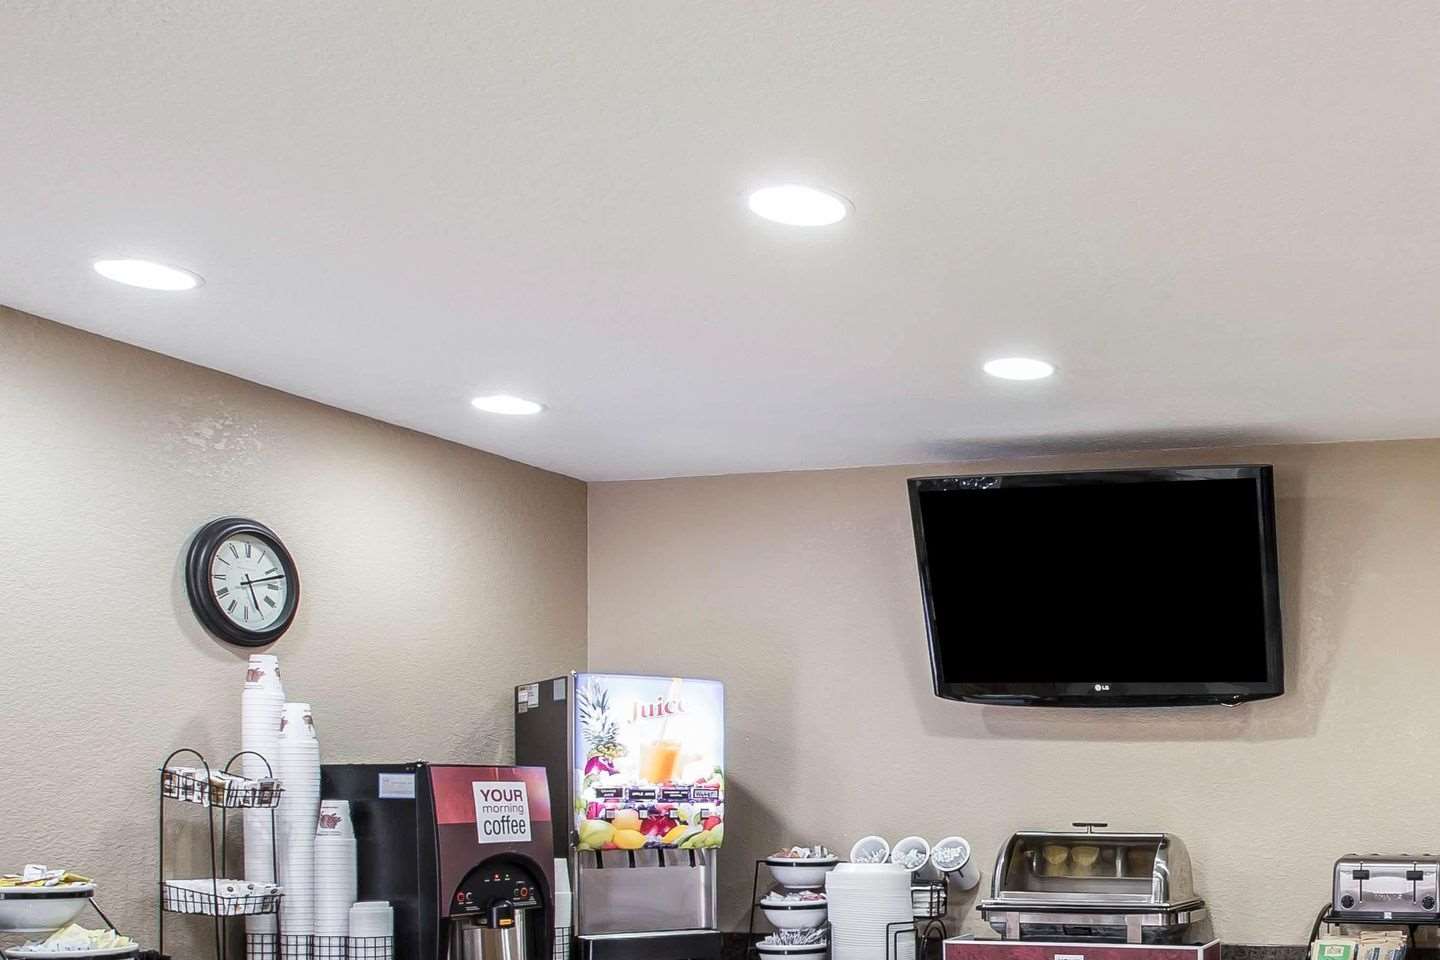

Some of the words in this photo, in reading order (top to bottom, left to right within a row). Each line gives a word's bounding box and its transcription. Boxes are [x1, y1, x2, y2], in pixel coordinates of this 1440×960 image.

[480, 788, 523, 802] YOUR
[482, 804, 524, 815] morning
[483, 815, 527, 836] coffee
